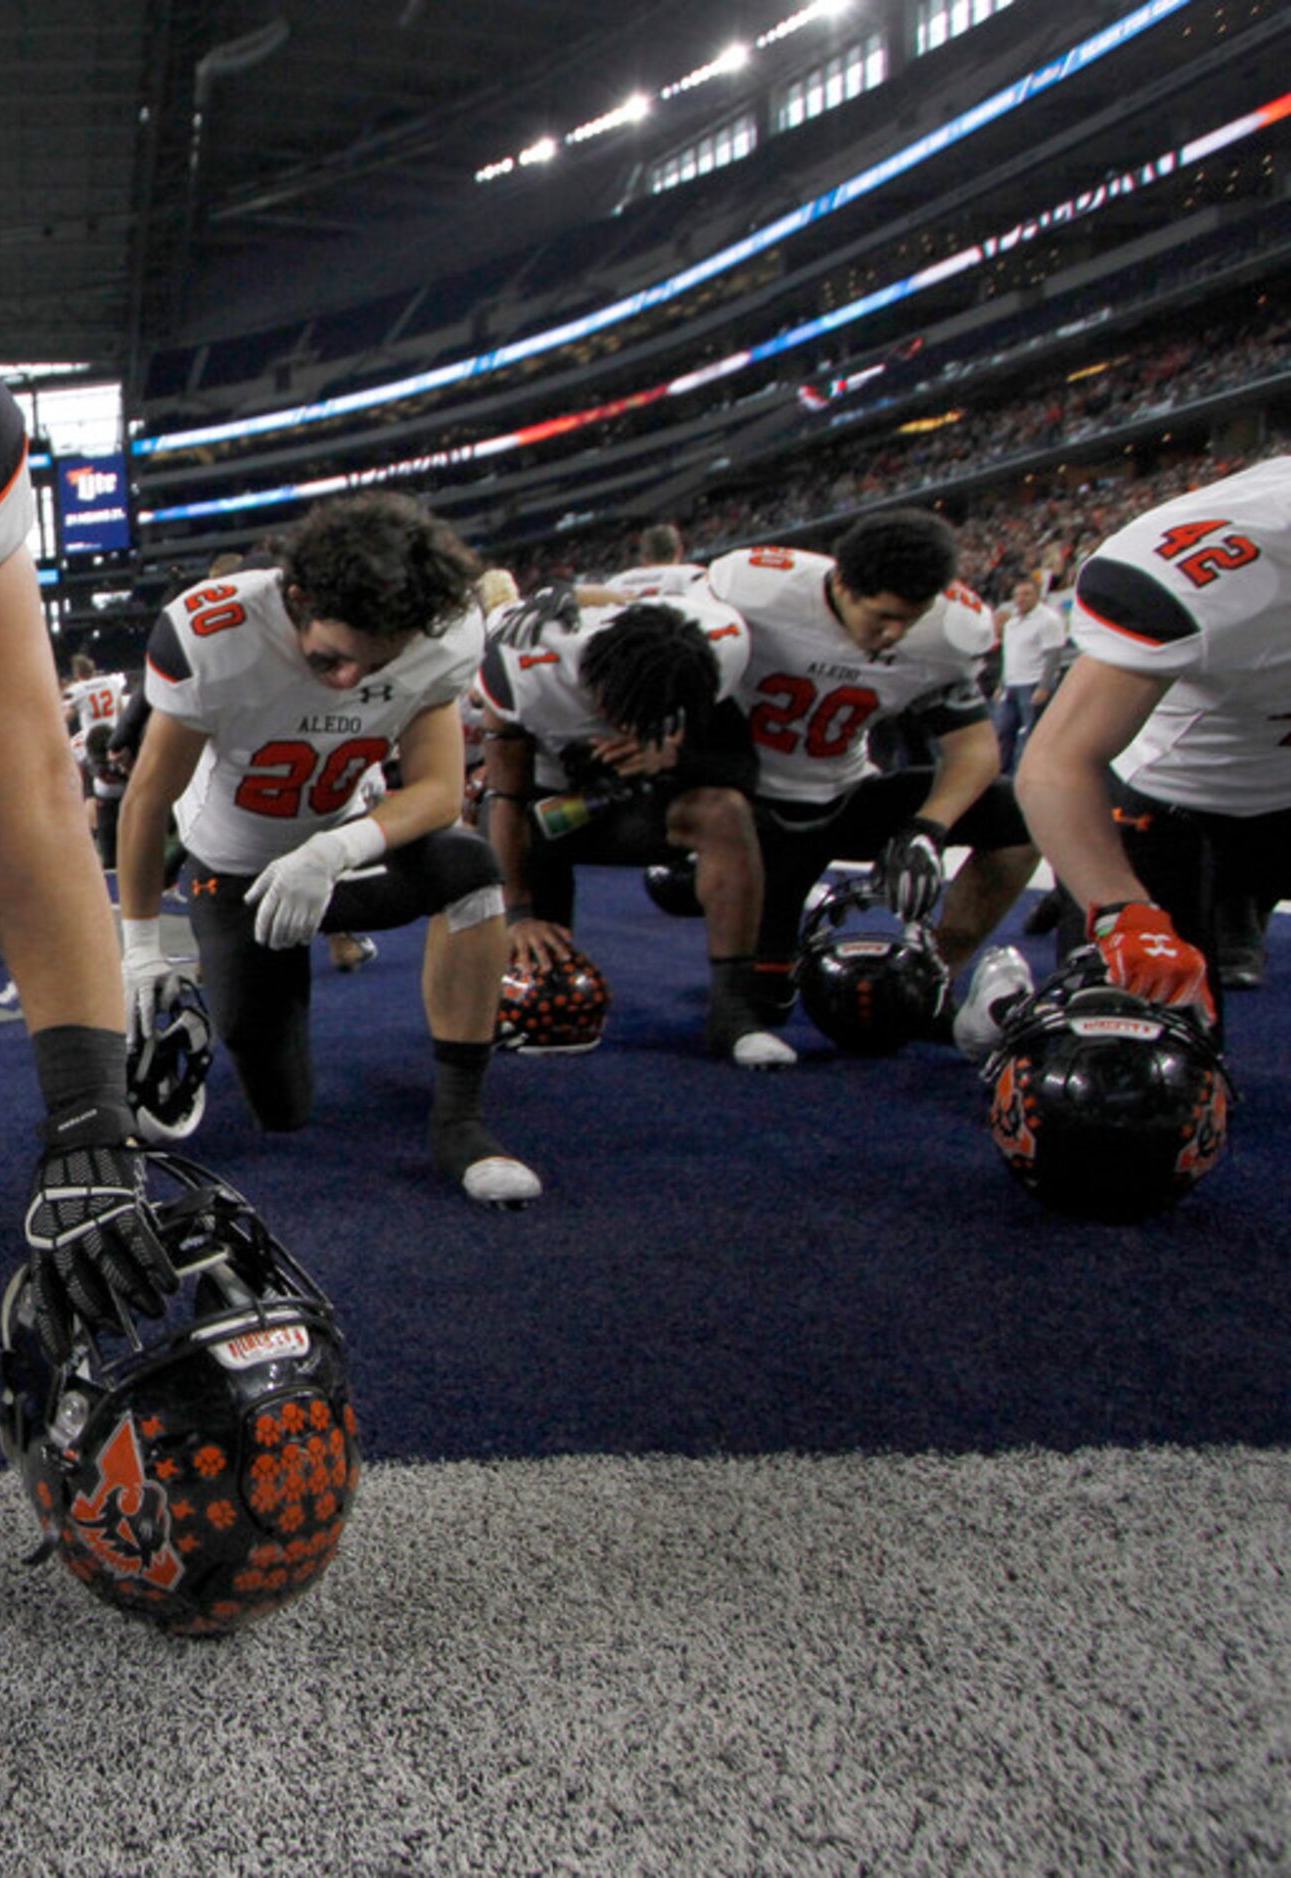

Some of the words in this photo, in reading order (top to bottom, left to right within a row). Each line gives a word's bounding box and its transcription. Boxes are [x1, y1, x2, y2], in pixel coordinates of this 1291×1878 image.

[1153, 518, 1260, 588] 42
[184, 584, 247, 638] 20
[709, 623, 741, 640] 1
[518, 651, 561, 671] 1
[89, 688, 115, 719] 12
[296, 715, 363, 734] ALEDO
[751, 671, 882, 759] 20
[234, 737, 391, 819] 20
